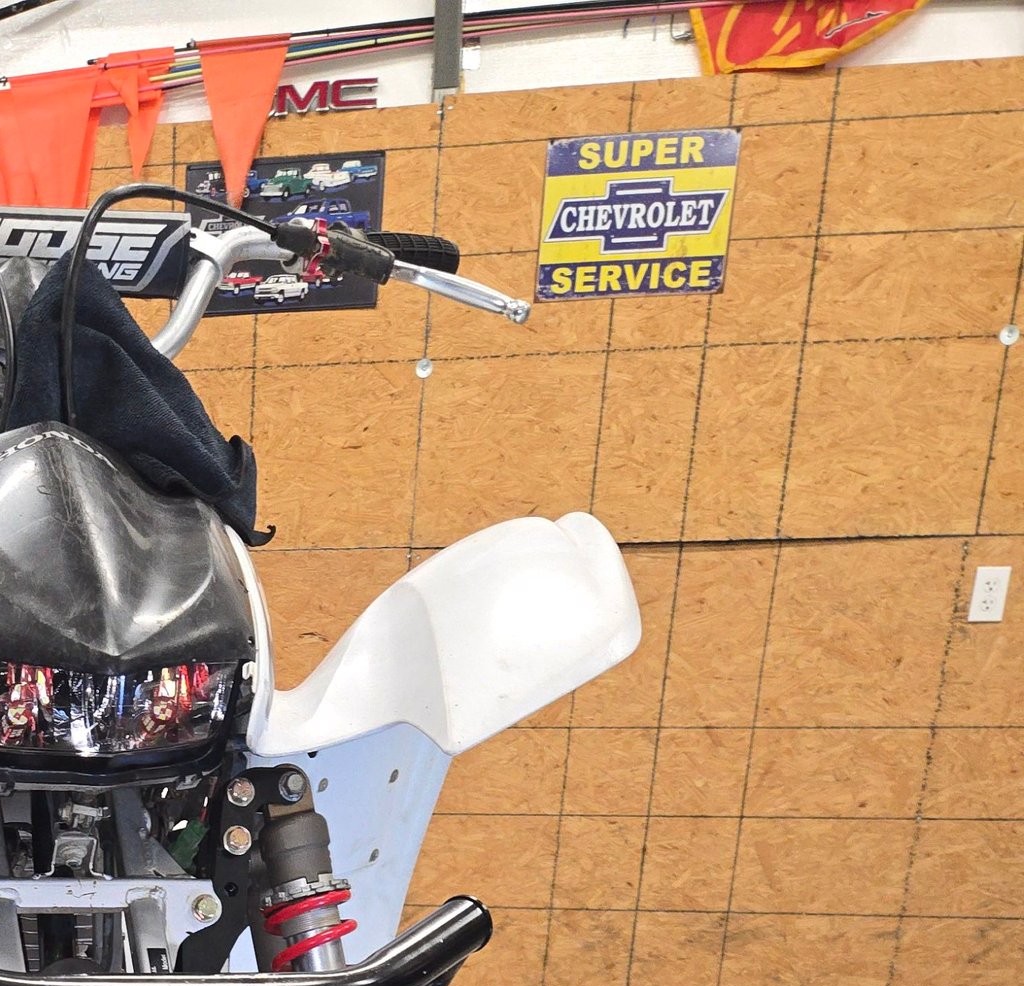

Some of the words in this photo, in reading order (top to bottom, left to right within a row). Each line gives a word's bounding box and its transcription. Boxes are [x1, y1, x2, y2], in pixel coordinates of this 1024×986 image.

[269, 77, 378, 117] MC
[578, 136, 705, 170] SUPER
[559, 199, 715, 233] CHEVROLET
[550, 260, 713, 295] SERVICE
